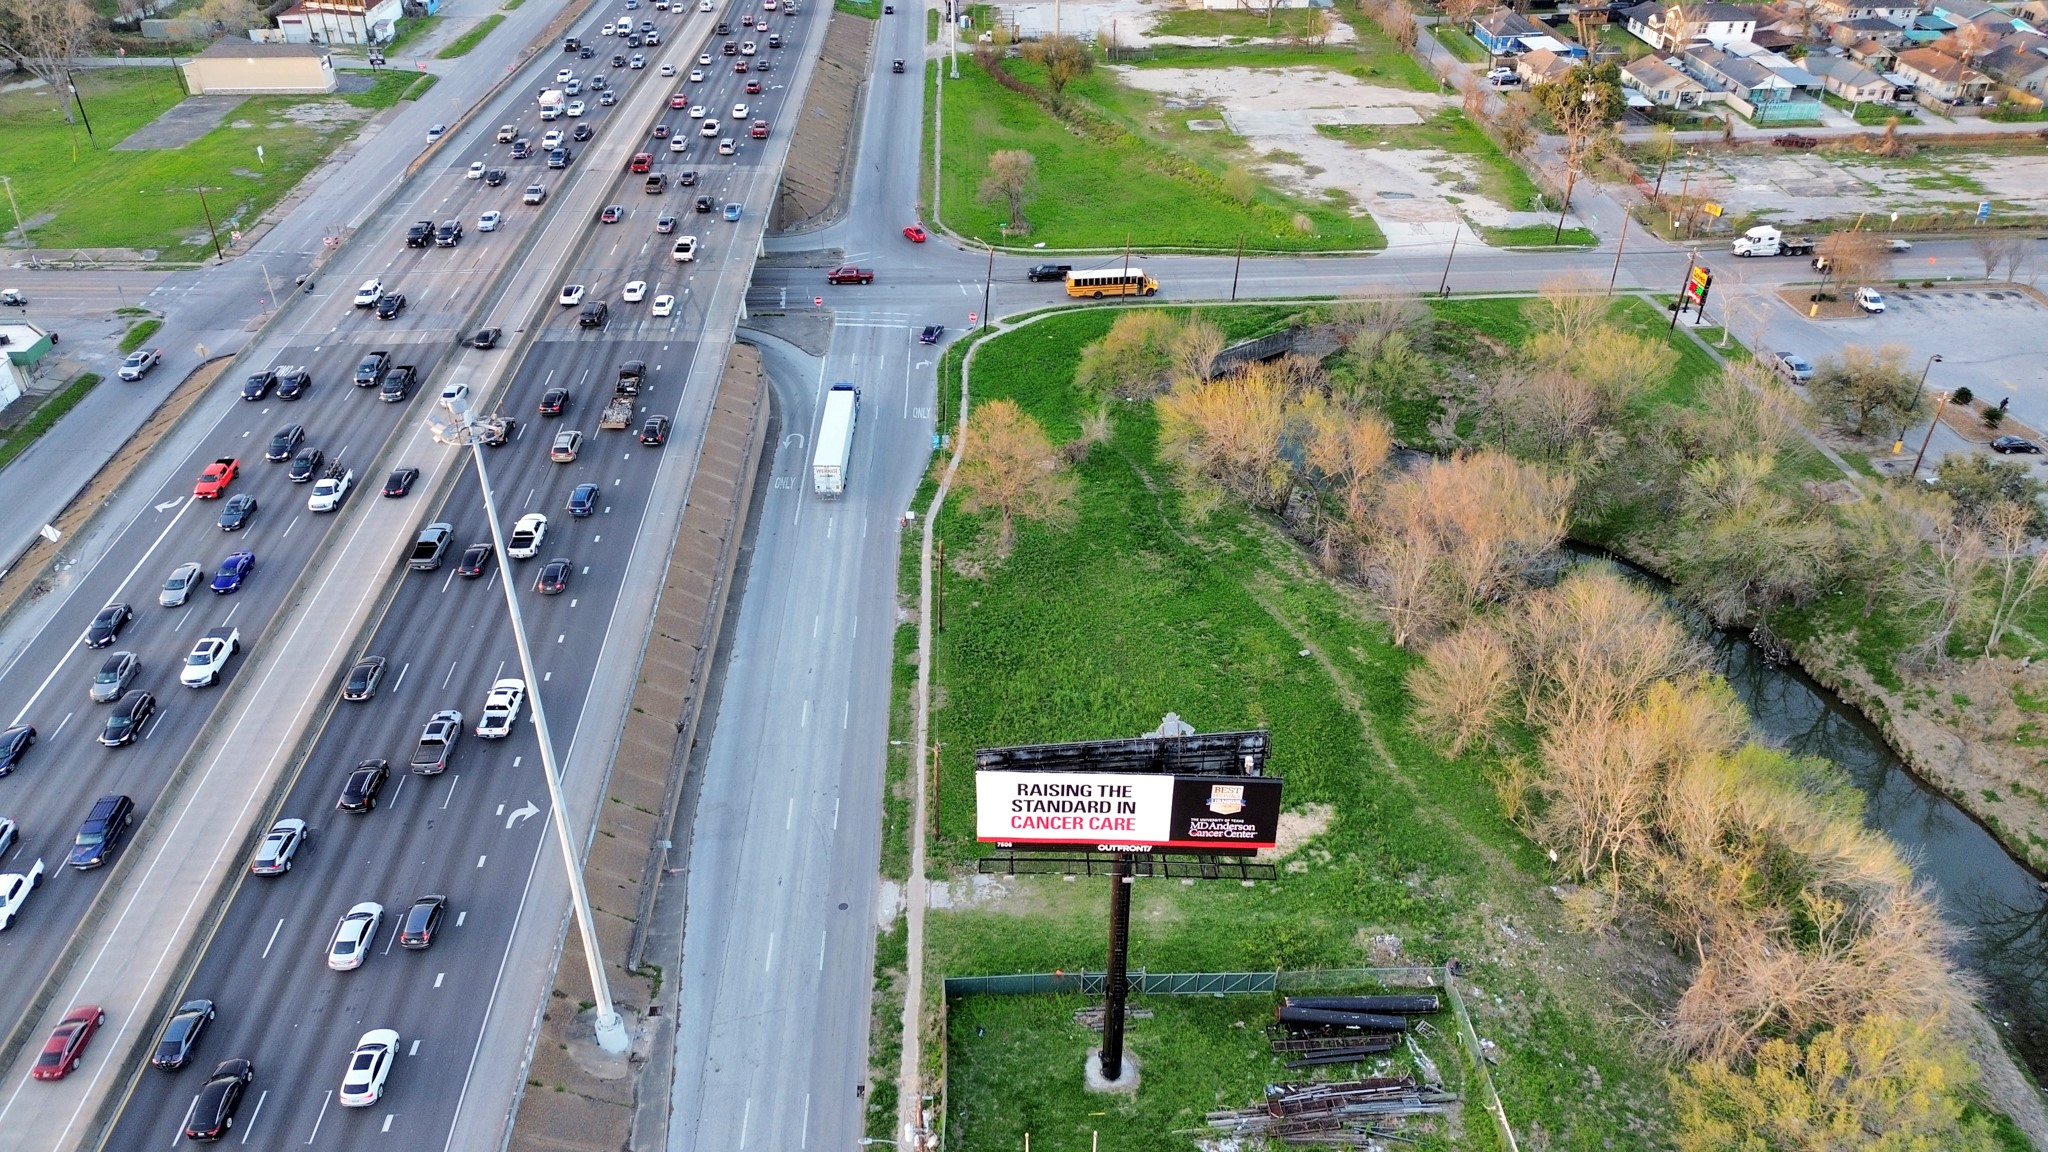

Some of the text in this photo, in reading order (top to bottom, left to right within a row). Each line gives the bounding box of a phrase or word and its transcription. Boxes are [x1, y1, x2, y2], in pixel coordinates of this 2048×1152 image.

[912, 407, 931, 418] ONLY
[774, 477, 796, 490] ONLY
[1017, 783, 1132, 798] RAISING THE
[1012, 799, 1136, 814] STANDARD IN
[1011, 816, 1136, 831] CANCER CARE
[1208, 822, 1255, 831] Anderson
[1189, 829, 1256, 838] Cancer Center
